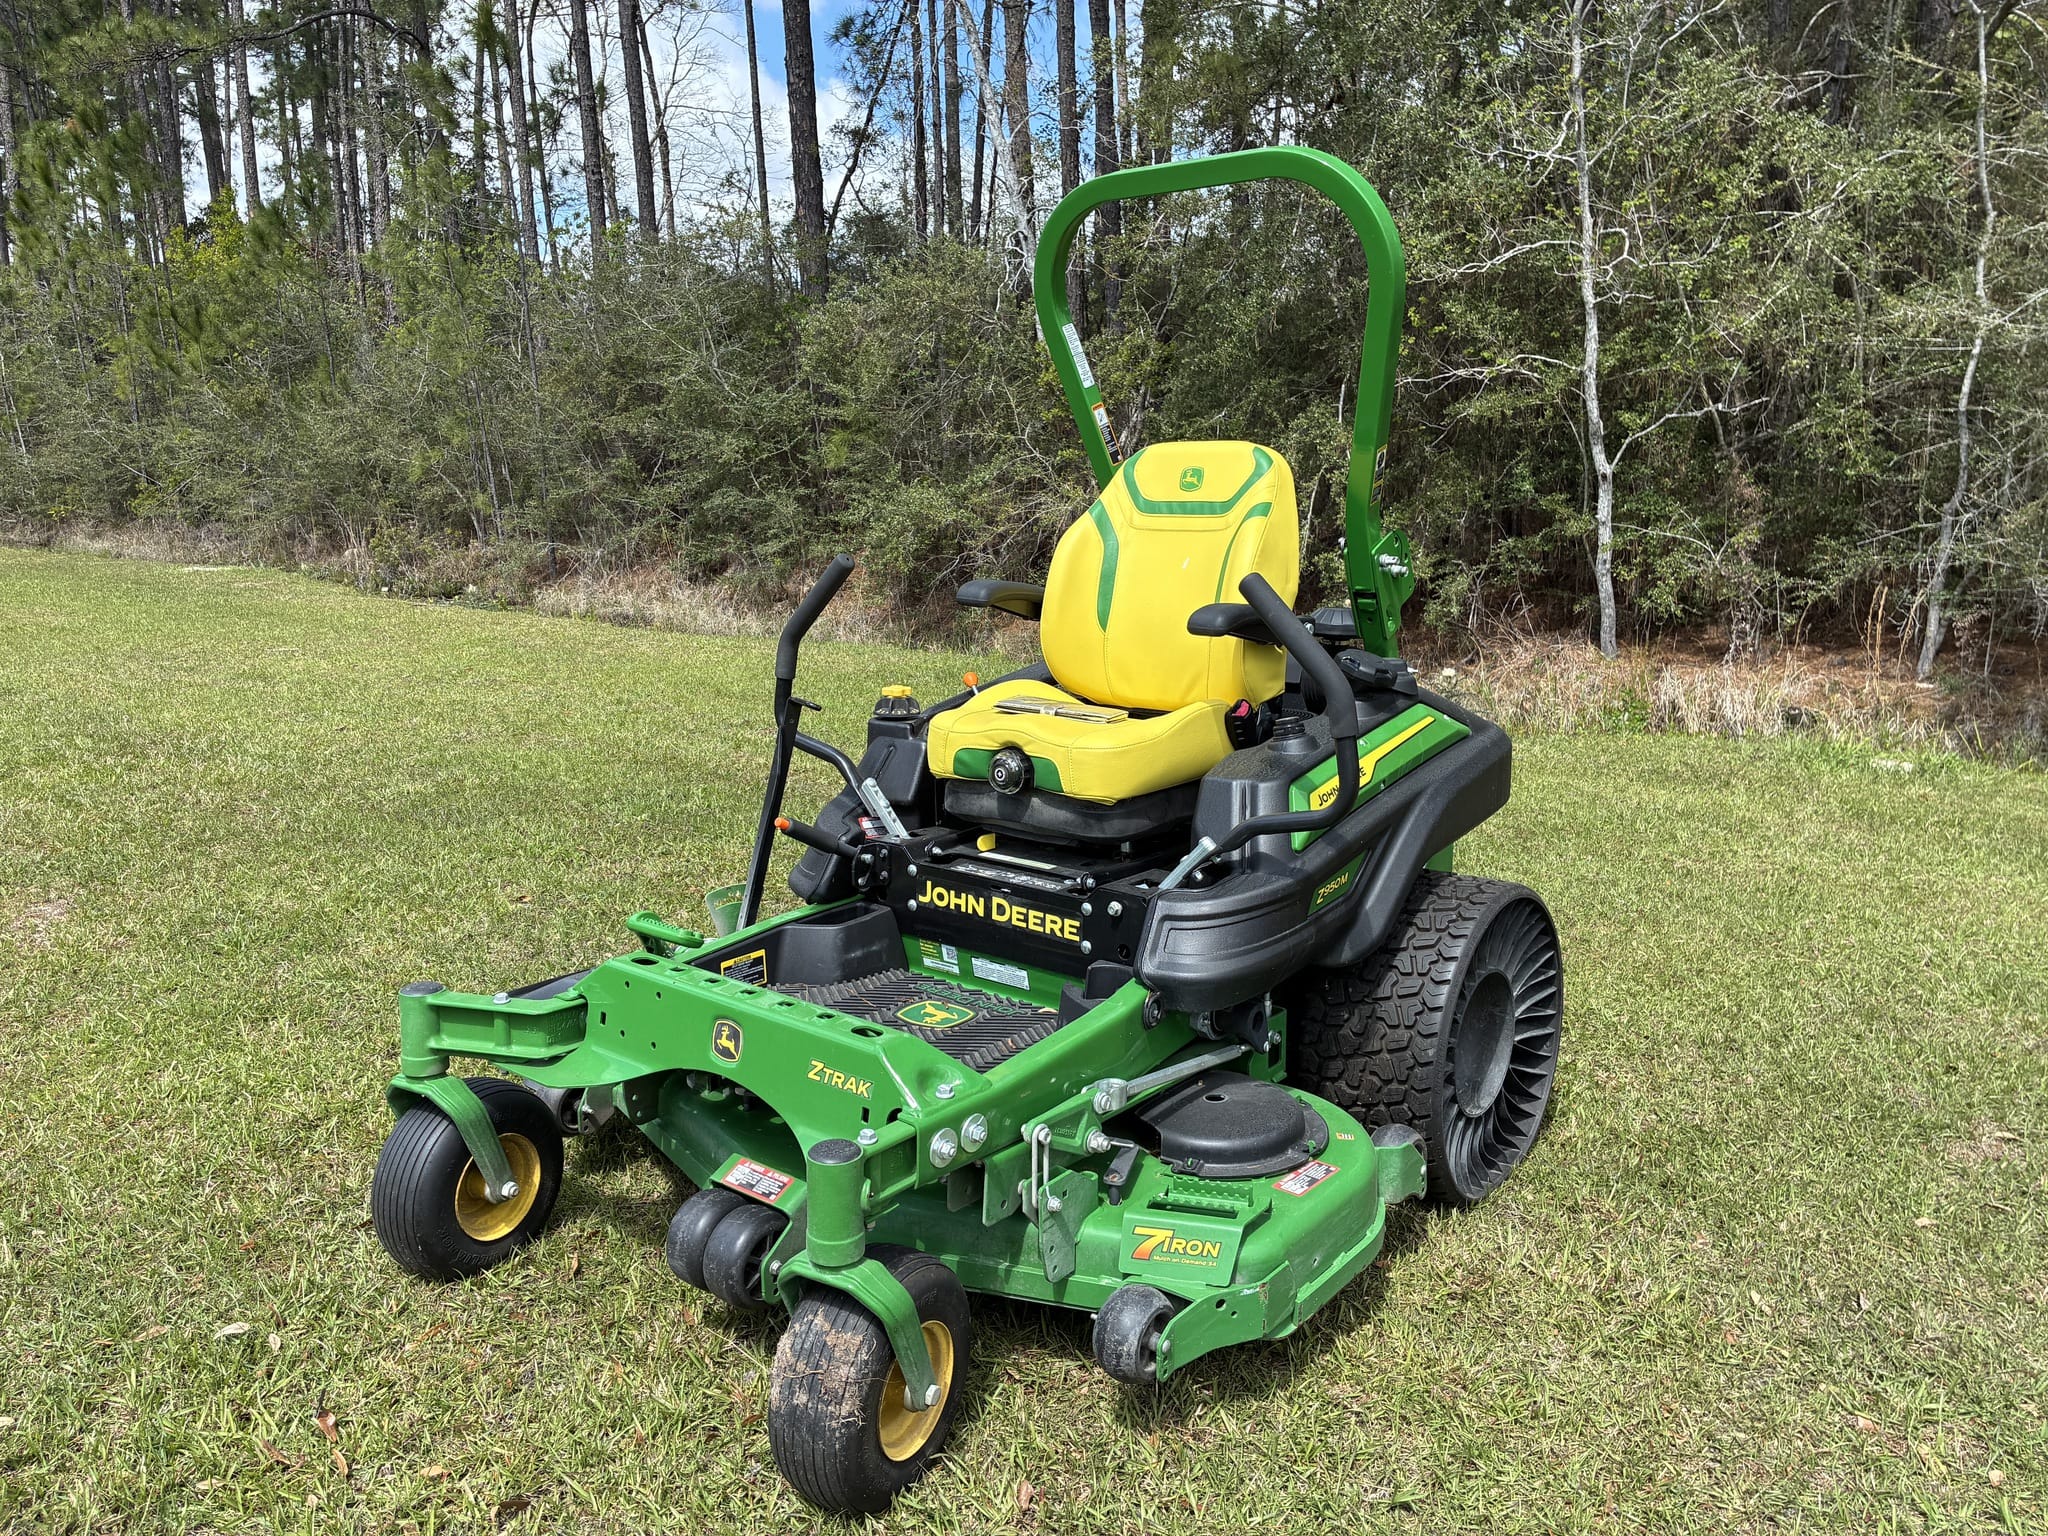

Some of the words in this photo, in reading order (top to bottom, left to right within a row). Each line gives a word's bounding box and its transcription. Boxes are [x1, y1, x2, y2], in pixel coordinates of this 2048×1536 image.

[1315, 871, 1349, 905] Z950M
[918, 880, 984, 917] JOHN
[991, 896, 1080, 942] DEERE
[807, 1058, 874, 1099] ZTRAK
